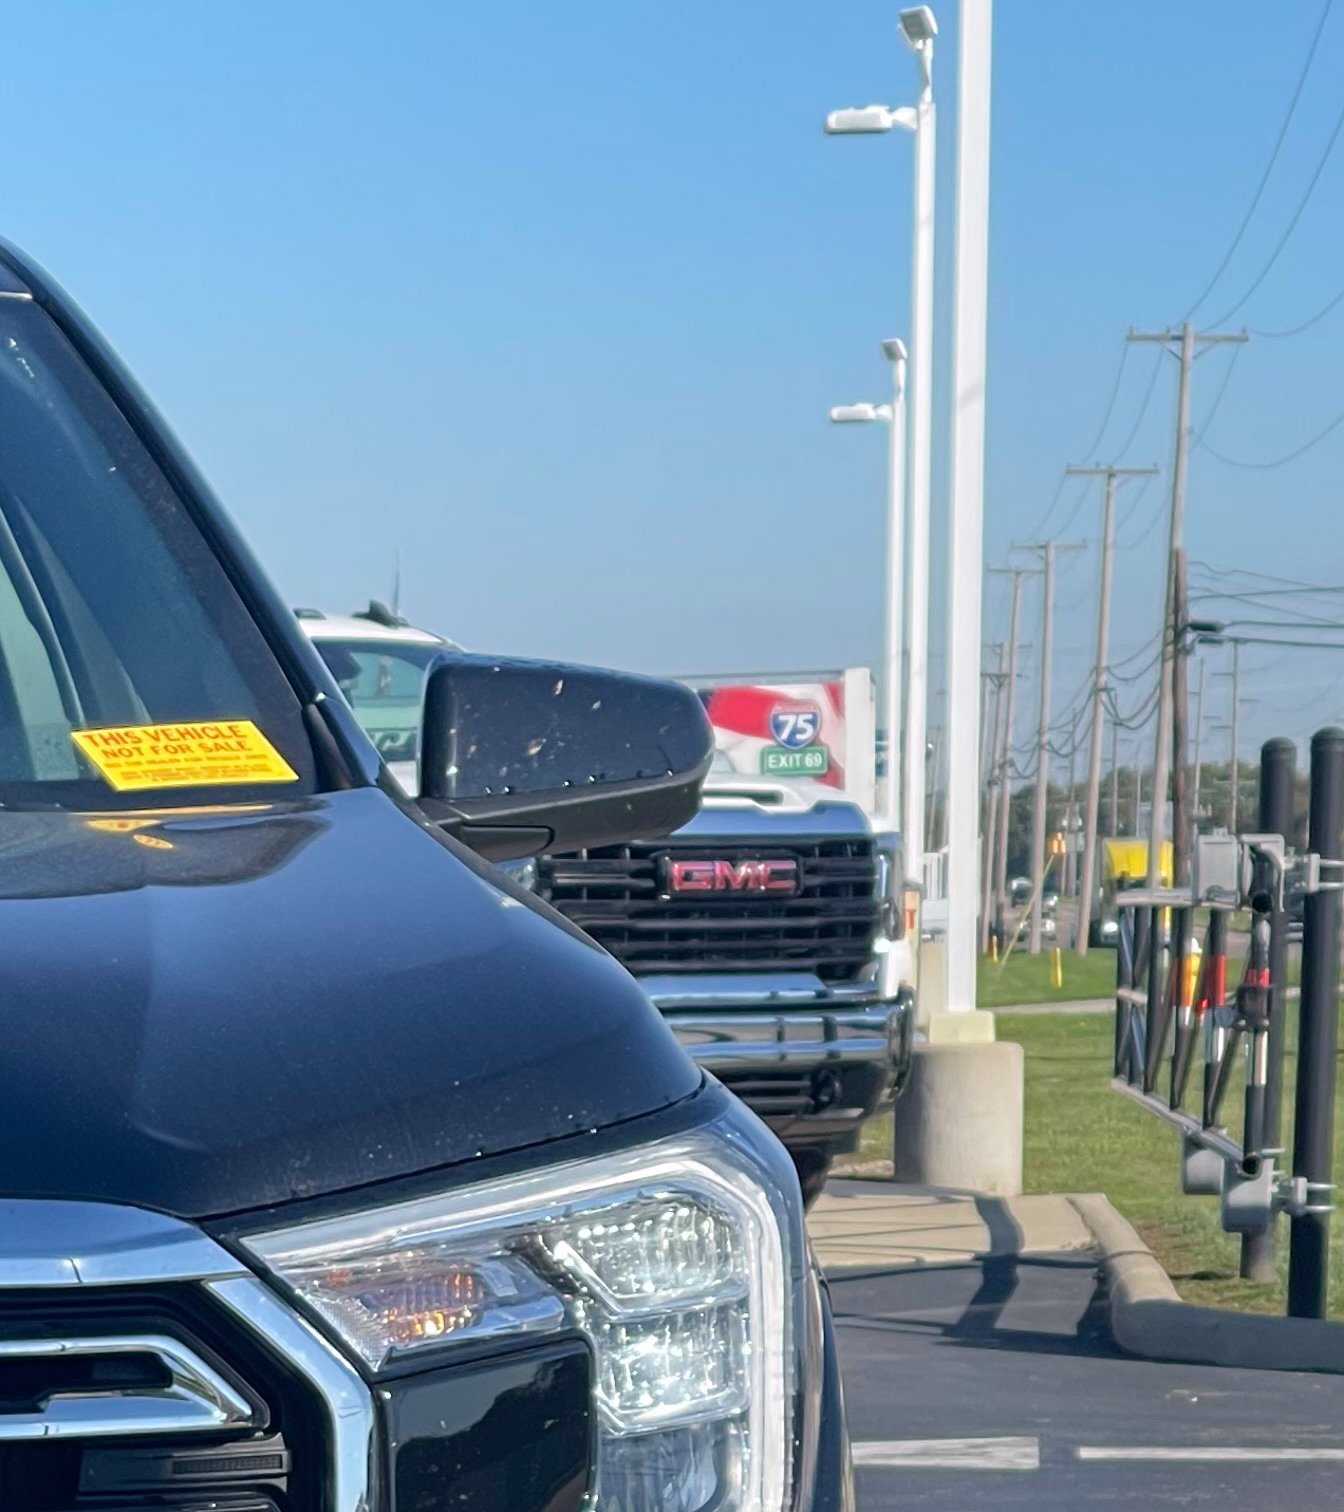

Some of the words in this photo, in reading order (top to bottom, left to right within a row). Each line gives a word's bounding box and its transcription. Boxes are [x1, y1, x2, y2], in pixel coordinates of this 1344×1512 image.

[82, 731, 143, 747] THIS
[143, 725, 248, 743] VEHICLE
[778, 713, 814, 740] 75
[101, 747, 146, 760] NOT
[149, 743, 194, 756] FOR
[198, 740, 254, 753] SALE
[768, 753, 802, 769] EXIT
[804, 752, 822, 767] 69
[672, 861, 797, 891] GMC
